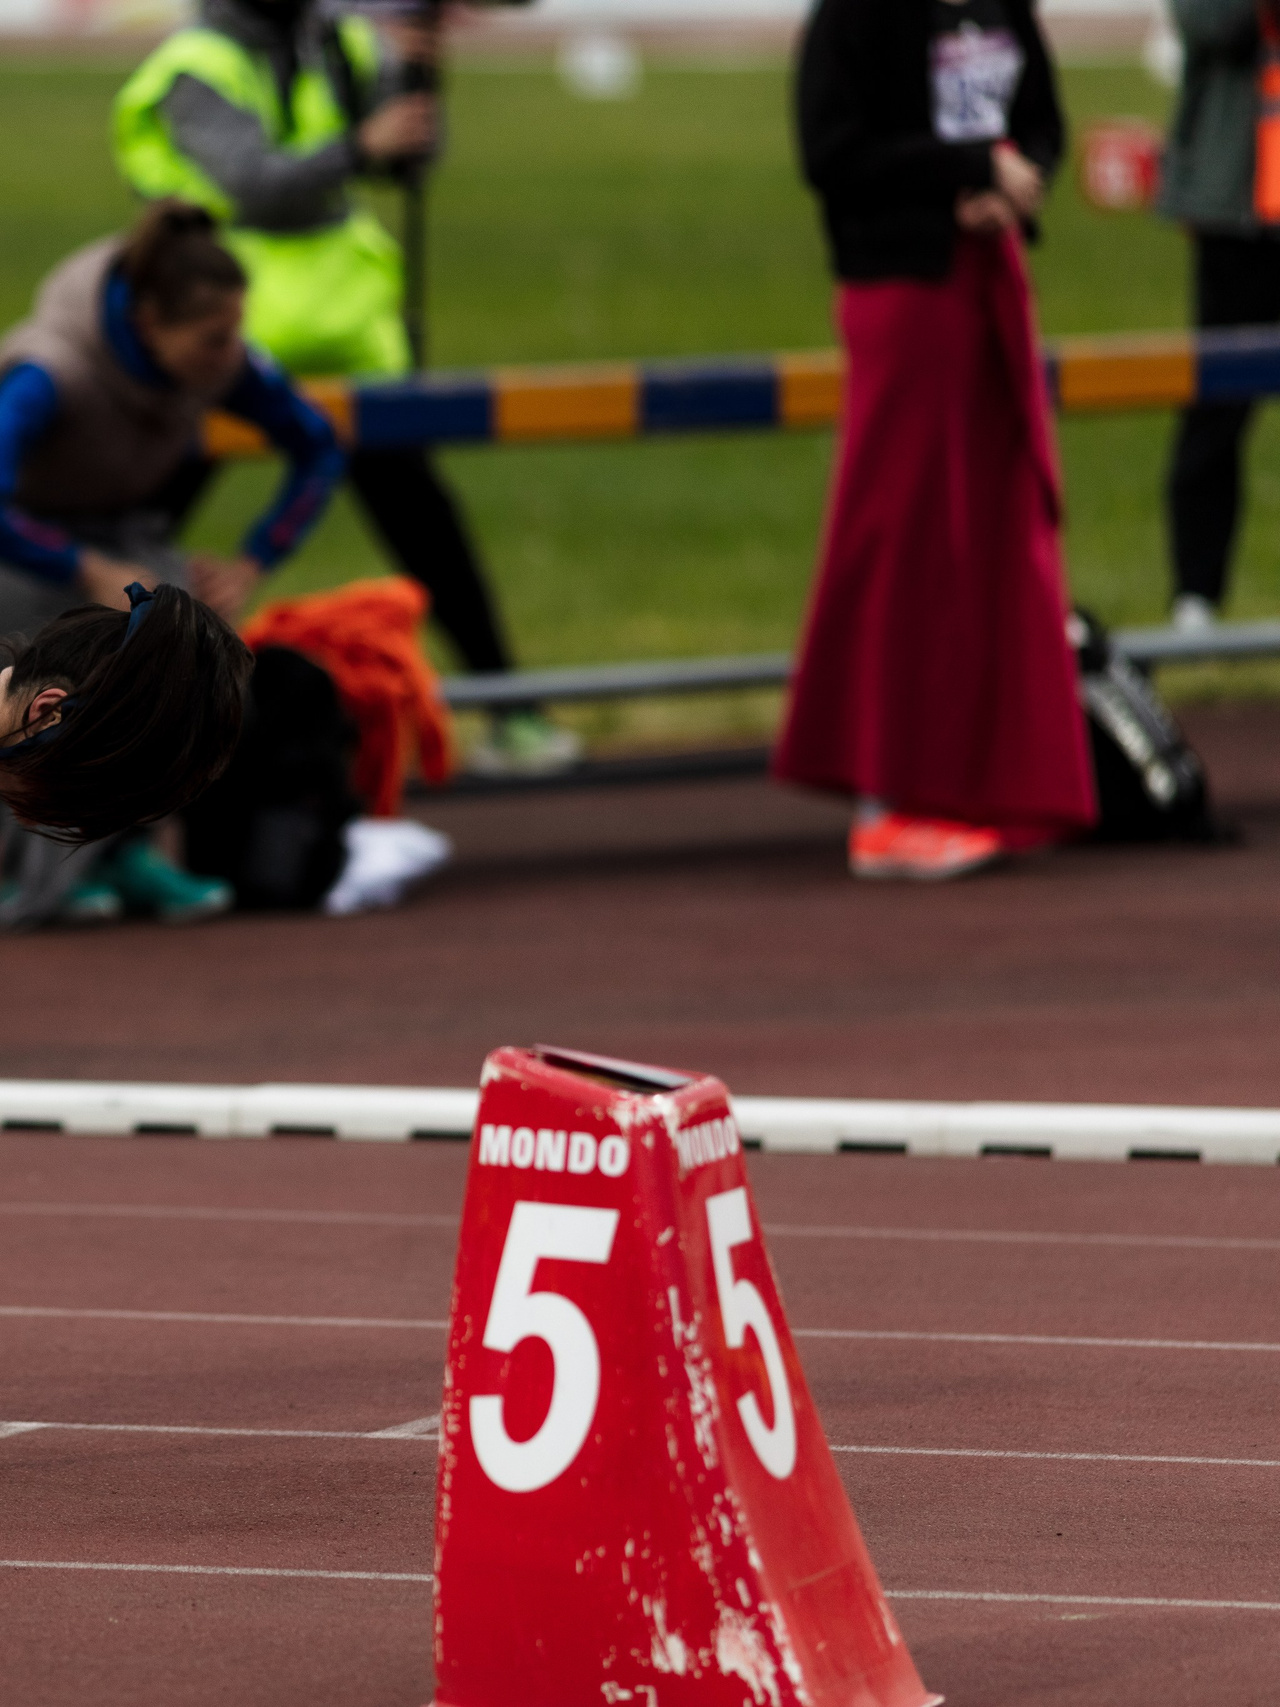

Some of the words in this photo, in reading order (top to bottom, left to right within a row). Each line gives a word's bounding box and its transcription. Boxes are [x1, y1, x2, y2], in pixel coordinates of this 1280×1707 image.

[478, 1123, 631, 1178] MONDO
[468, 1200, 621, 1494] 5
[705, 1186, 798, 1481] 5
